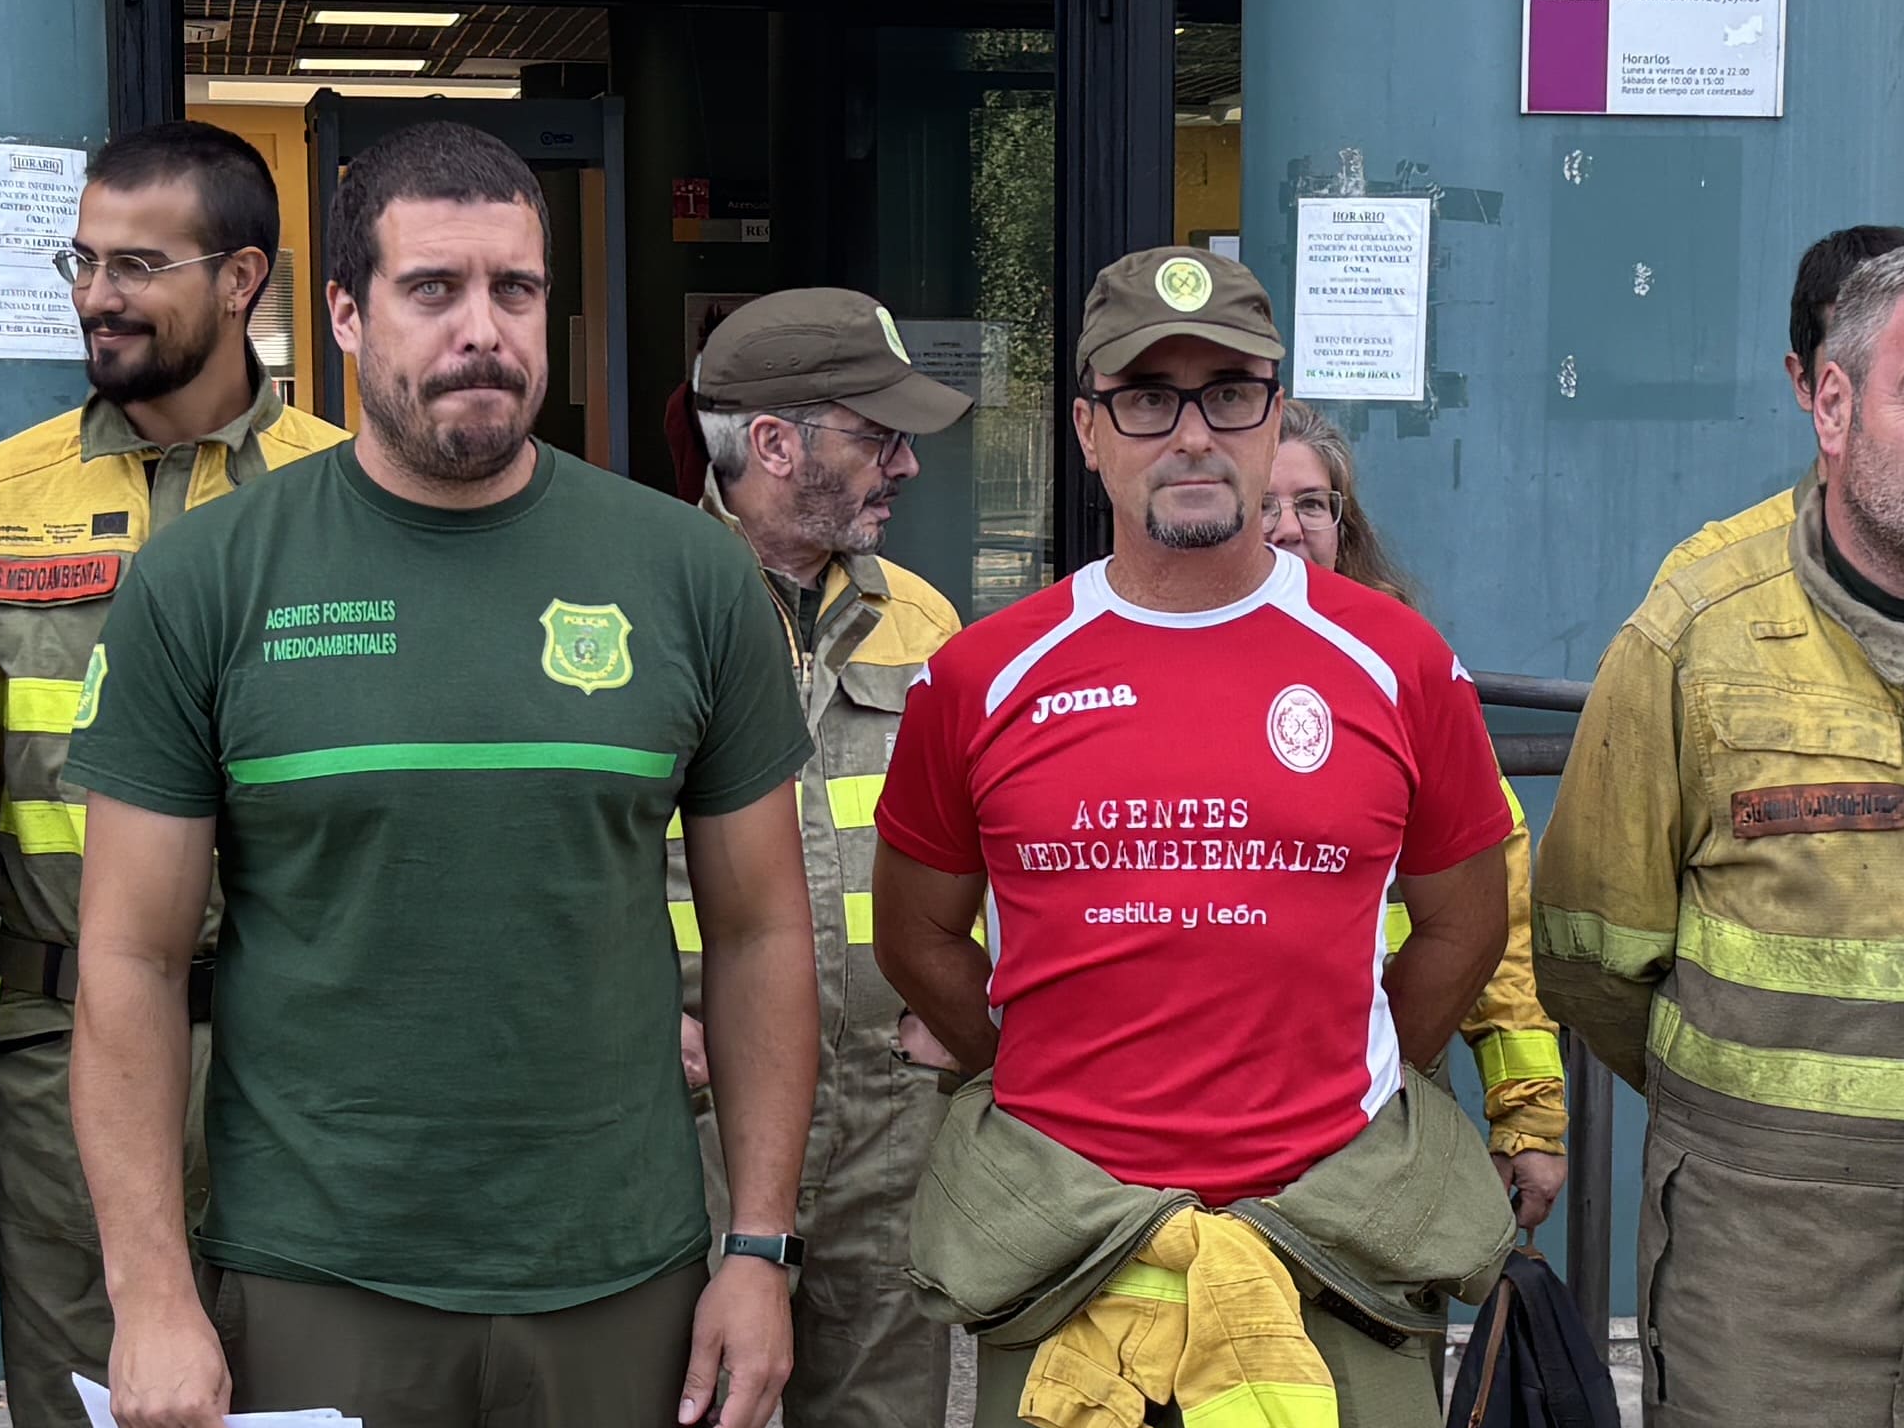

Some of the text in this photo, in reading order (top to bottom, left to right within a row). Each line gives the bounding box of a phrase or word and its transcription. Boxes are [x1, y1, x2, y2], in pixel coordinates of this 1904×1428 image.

[1622, 52, 1671, 65] Horarios
[13, 156, 60, 171] HORARIO
[1332, 211, 1386, 222] HORARIO
[264, 599, 396, 630] AGENTES FORESTALES
[262, 632, 398, 663] Y MEDIOAMBIENTALES
[1071, 797, 1250, 831] AGENTES
[1015, 839, 1351, 874] MEDIOAMBIENTALES
[1084, 901, 1268, 929] castilla y león
